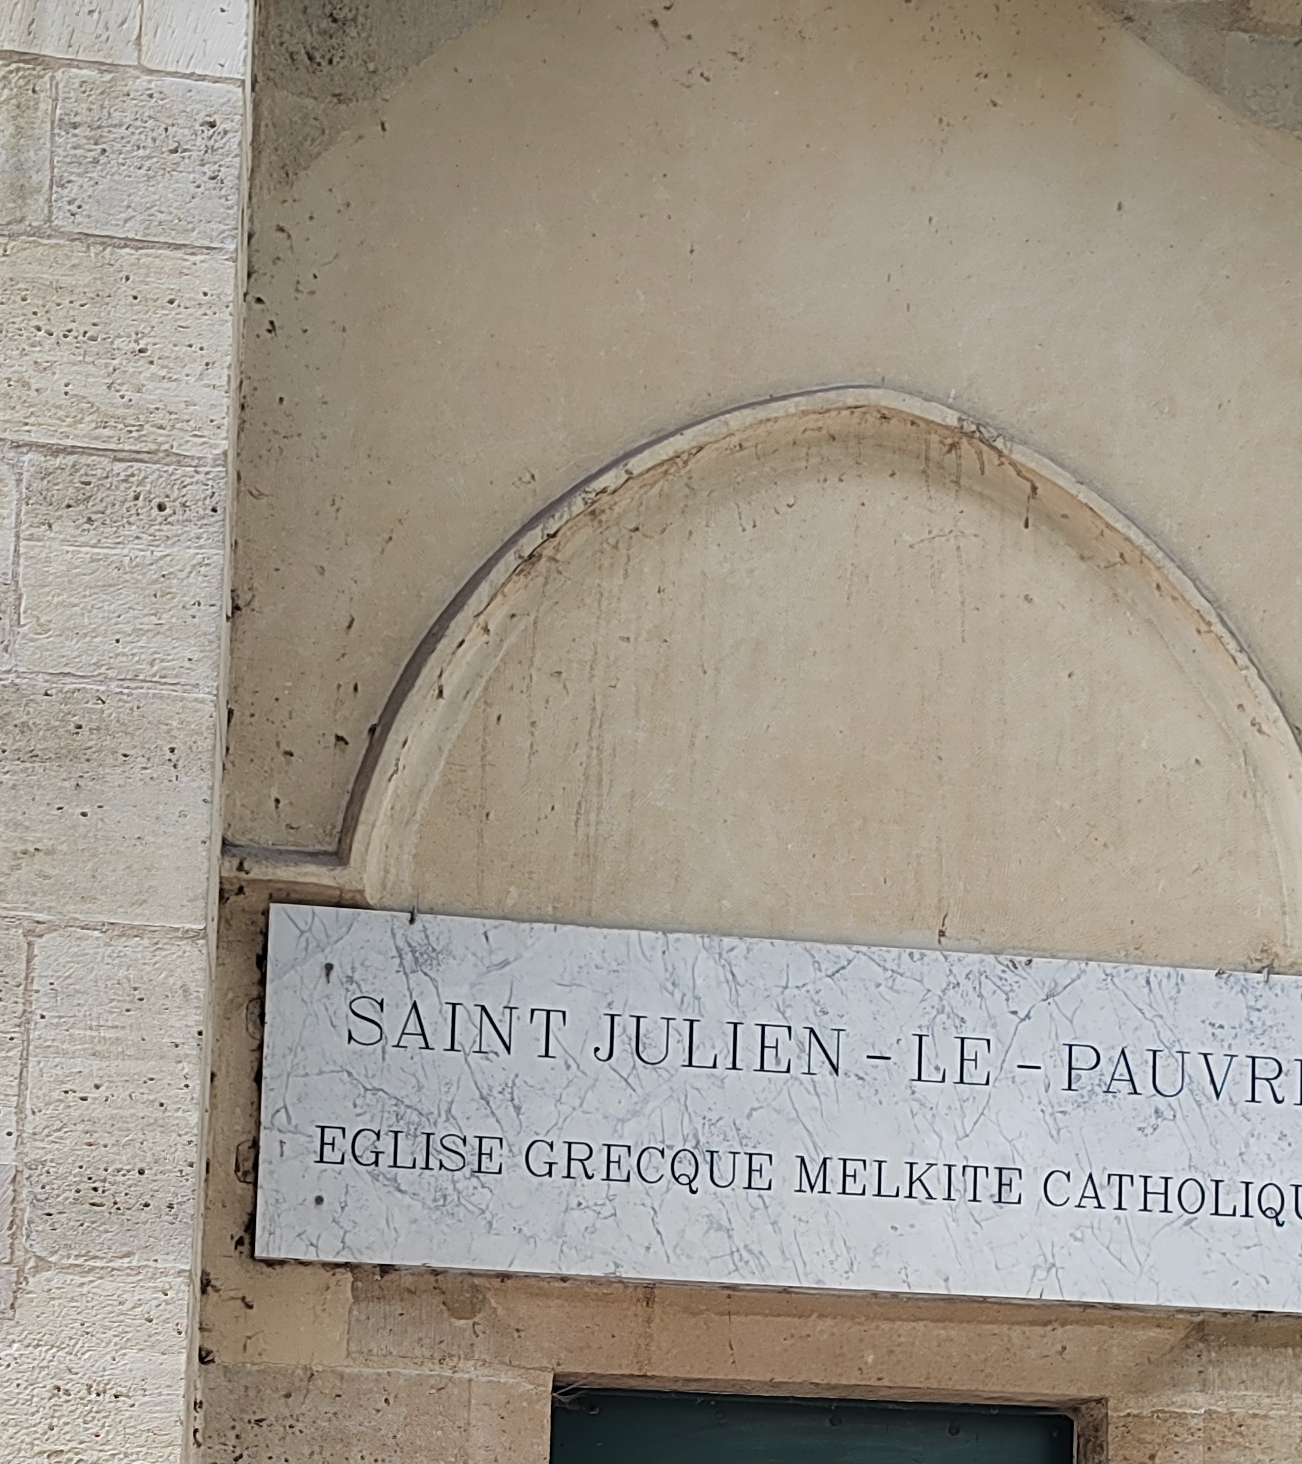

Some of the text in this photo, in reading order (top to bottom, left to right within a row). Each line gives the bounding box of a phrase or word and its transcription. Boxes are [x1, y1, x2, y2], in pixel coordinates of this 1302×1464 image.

[347, 995, 567, 1059] SAINT
[593, 1012, 847, 1078] JULIEN
[313, 1124, 504, 1175] EGLISE
[524, 1139, 773, 1195] GRECQUE
[793, 1154, 1023, 1205] MELKITE
